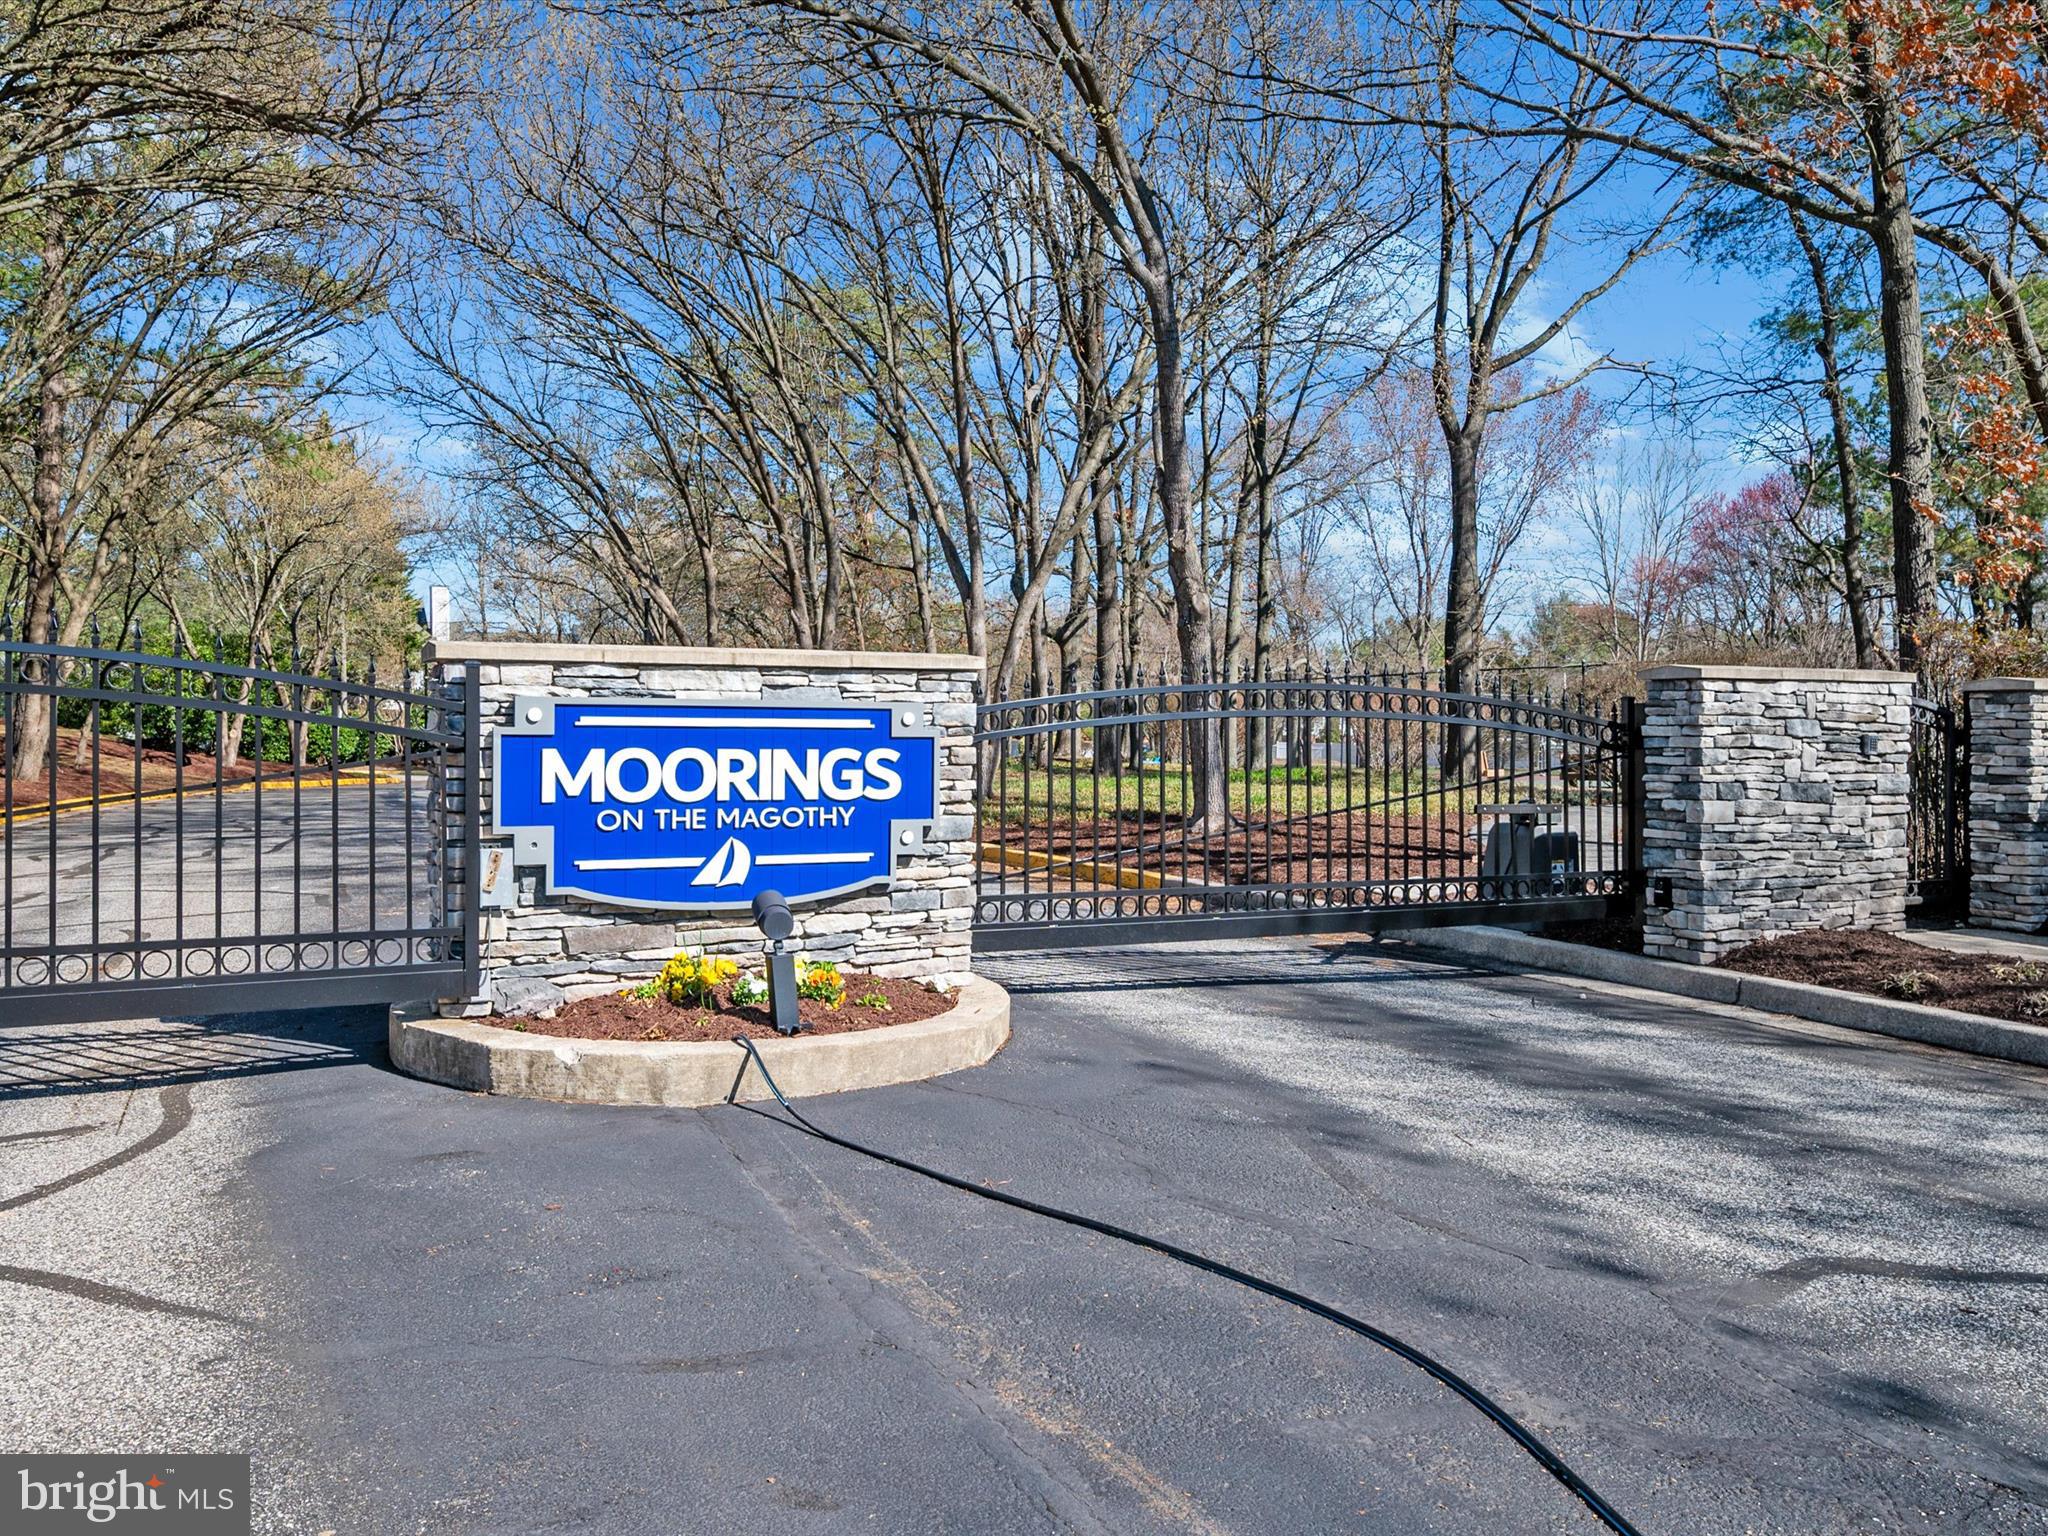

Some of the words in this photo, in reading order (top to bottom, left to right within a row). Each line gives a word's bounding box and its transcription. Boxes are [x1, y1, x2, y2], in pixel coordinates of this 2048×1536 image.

[541, 747, 903, 804] MOORINGS
[596, 809, 644, 831] ON
[654, 808, 707, 830] THE
[716, 806, 856, 829] MAGOTHY
